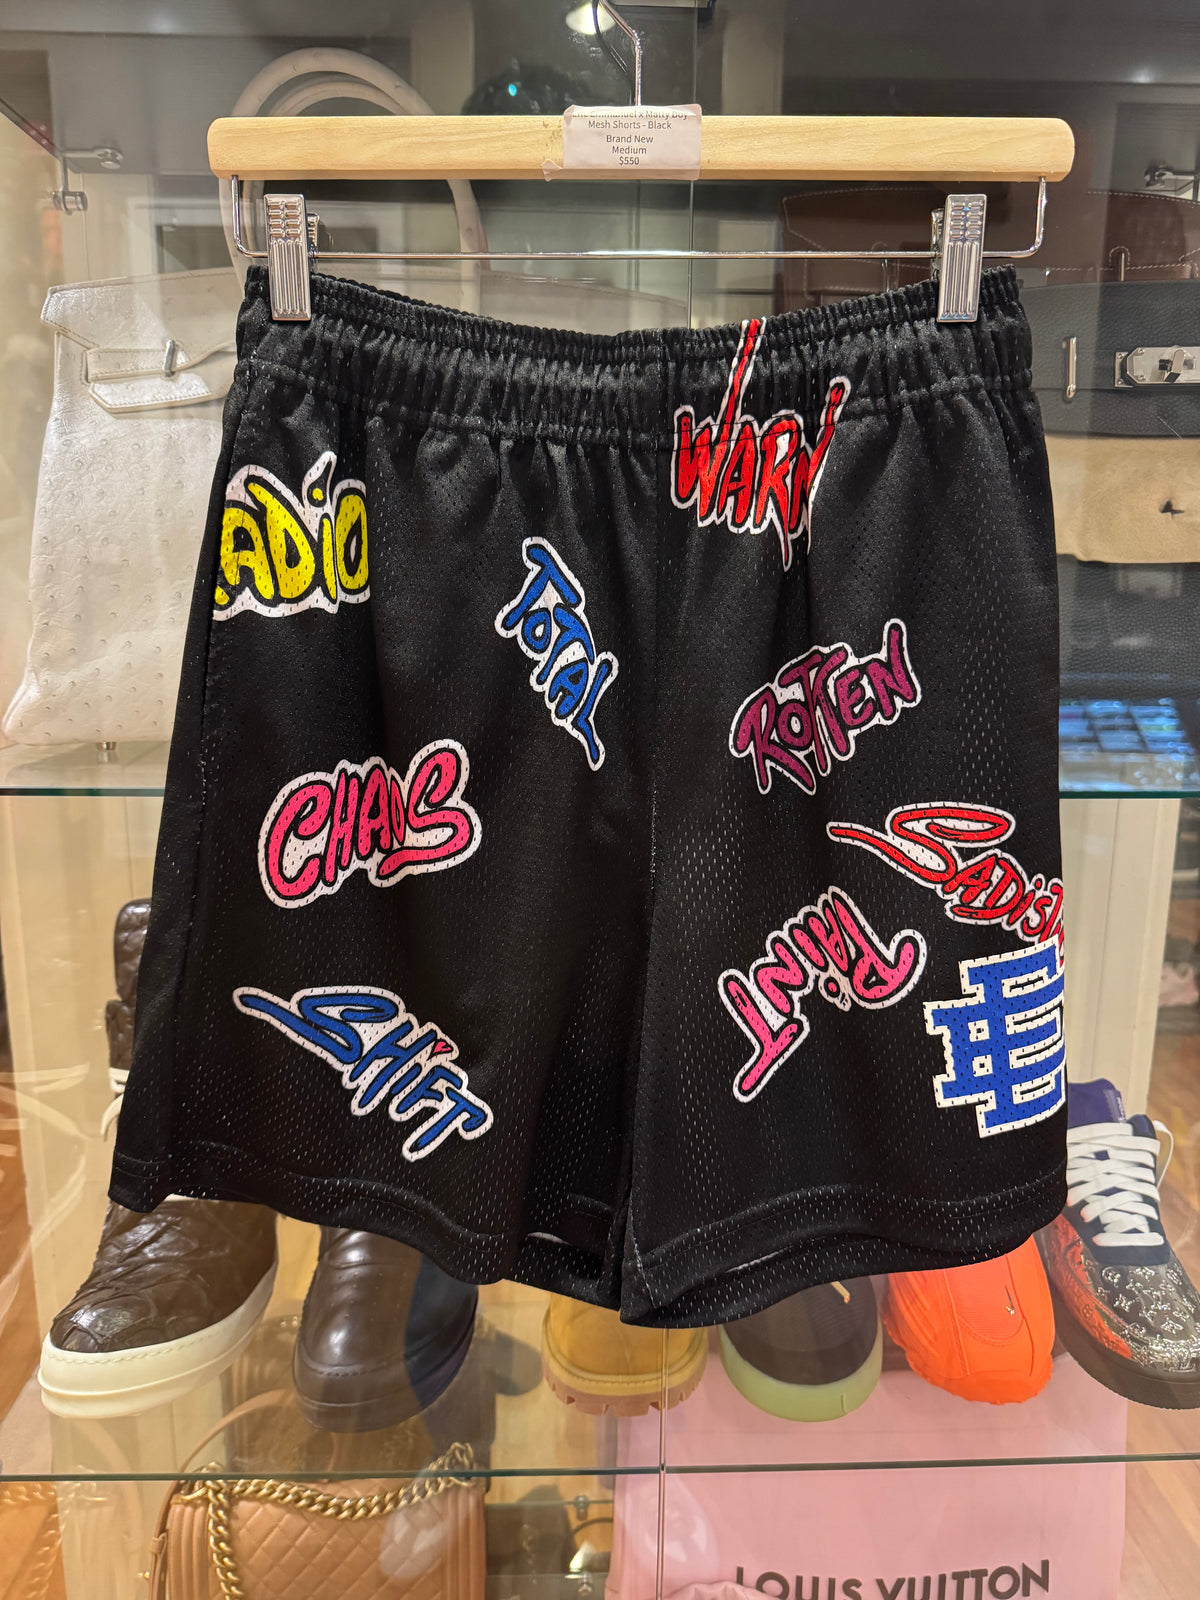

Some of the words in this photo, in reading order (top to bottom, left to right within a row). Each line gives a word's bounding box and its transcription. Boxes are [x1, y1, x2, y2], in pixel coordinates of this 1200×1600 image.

[588, 120, 610, 129] Mesh
[612, 120, 641, 129] Shorts
[647, 120, 672, 129] Black
[606, 134, 632, 143] Brand
[634, 135, 654, 143] New
[612, 145, 647, 154] Medium
[619, 156, 640, 166] $550
[258, 739, 483, 909] CHAOS
[875, 1559, 1050, 1600] VUITTON
